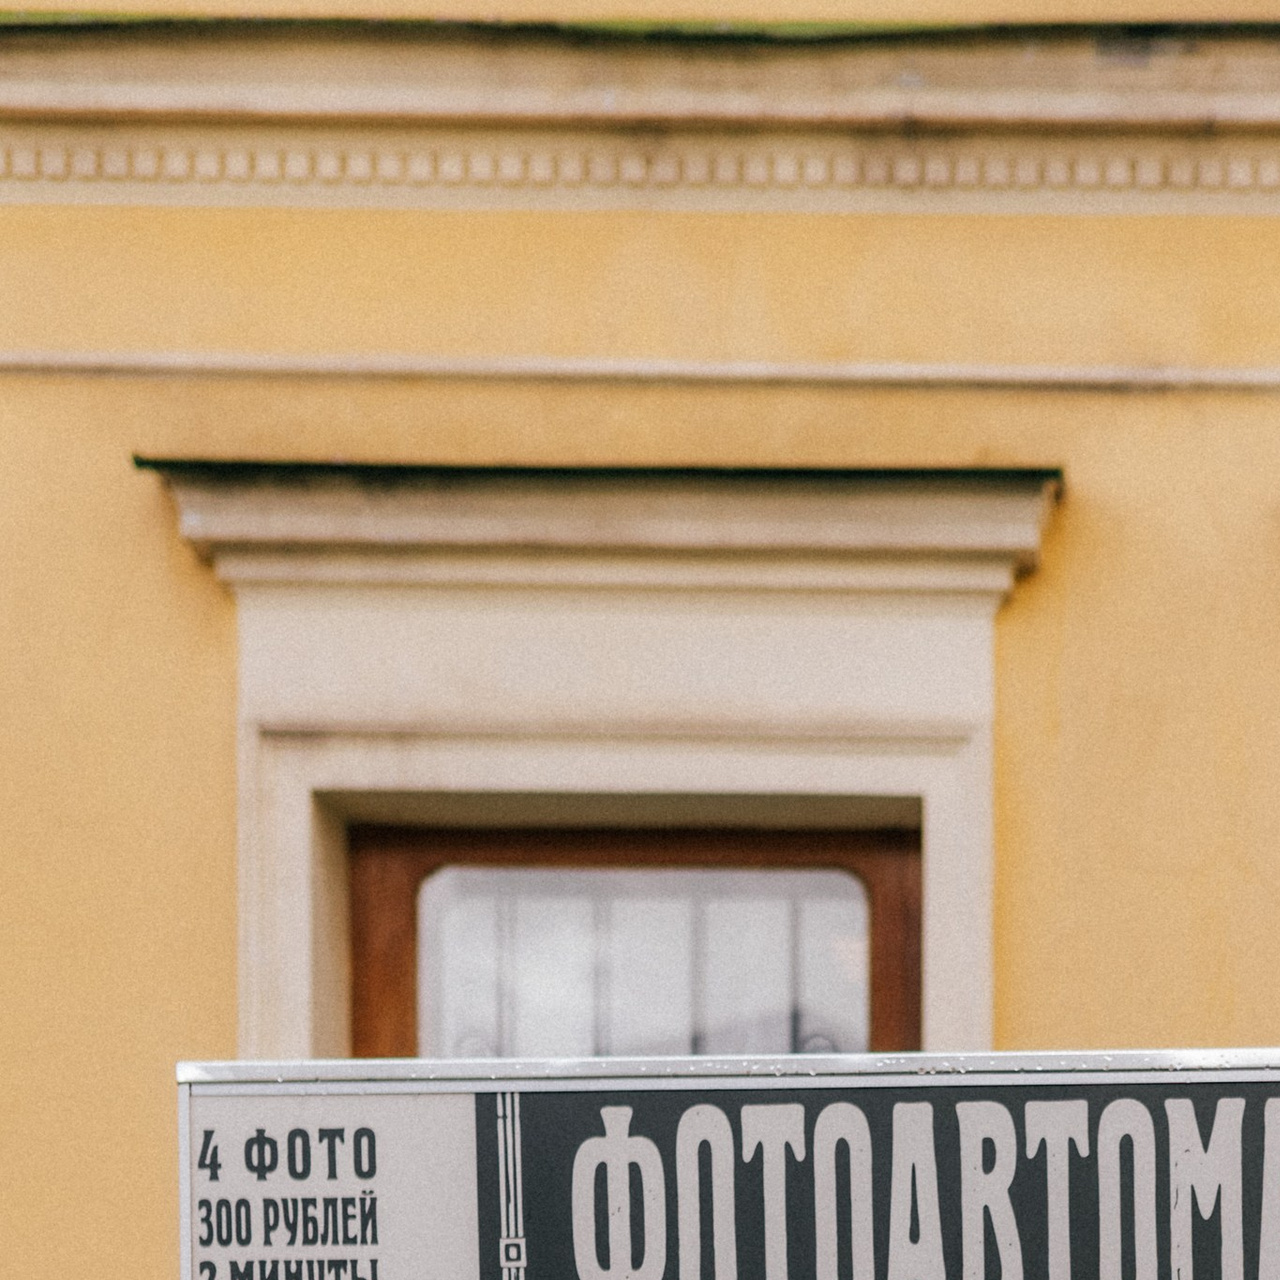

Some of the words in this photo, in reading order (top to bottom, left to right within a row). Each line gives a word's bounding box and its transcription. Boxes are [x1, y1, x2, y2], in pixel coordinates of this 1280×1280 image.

[197, 1129, 222, 1181] 4
[244, 1127, 377, 1181] ФОТО
[198, 1198, 252, 1247] 300
[262, 1189, 379, 1247] РУБЛЕЙ
